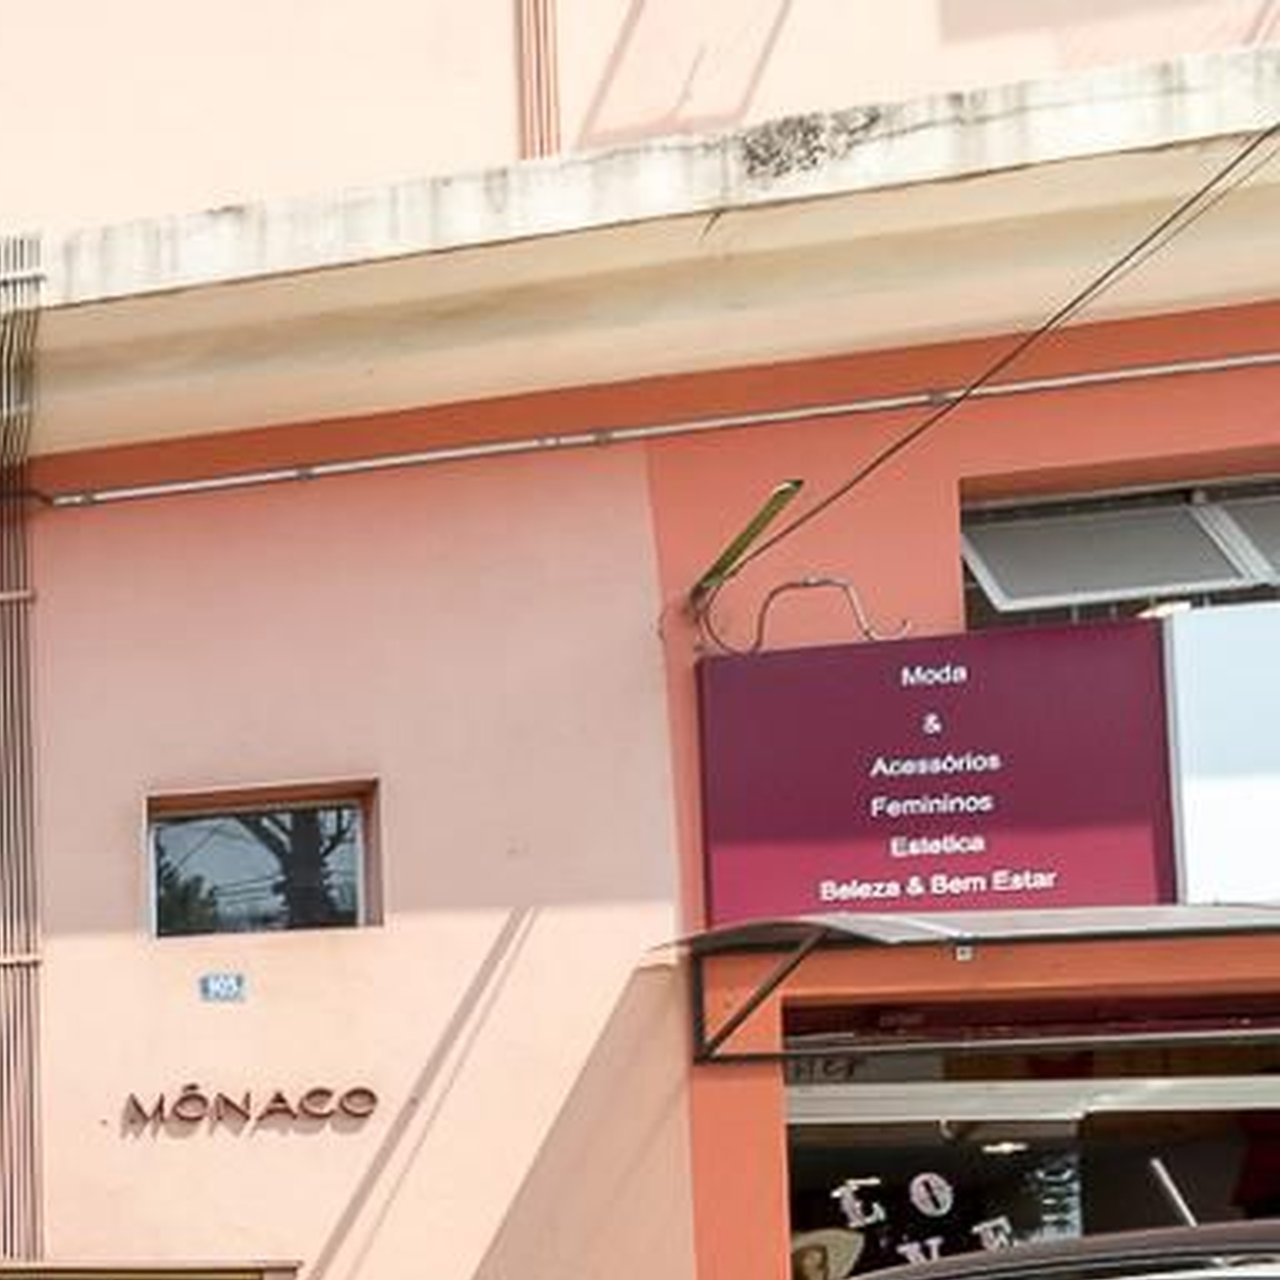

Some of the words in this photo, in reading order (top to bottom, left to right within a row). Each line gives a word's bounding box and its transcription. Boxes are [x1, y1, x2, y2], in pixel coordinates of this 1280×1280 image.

[901, 662, 968, 687] Moda
[921, 712, 942, 734] &
[869, 752, 1000, 778] Acessórios
[871, 794, 994, 817] Femininos
[819, 879, 900, 901] Beleza
[905, 875, 925, 896] &
[930, 873, 987, 894] Bem
[992, 868, 1058, 892] Estar
[126, 1083, 379, 1124] MÔNACO
